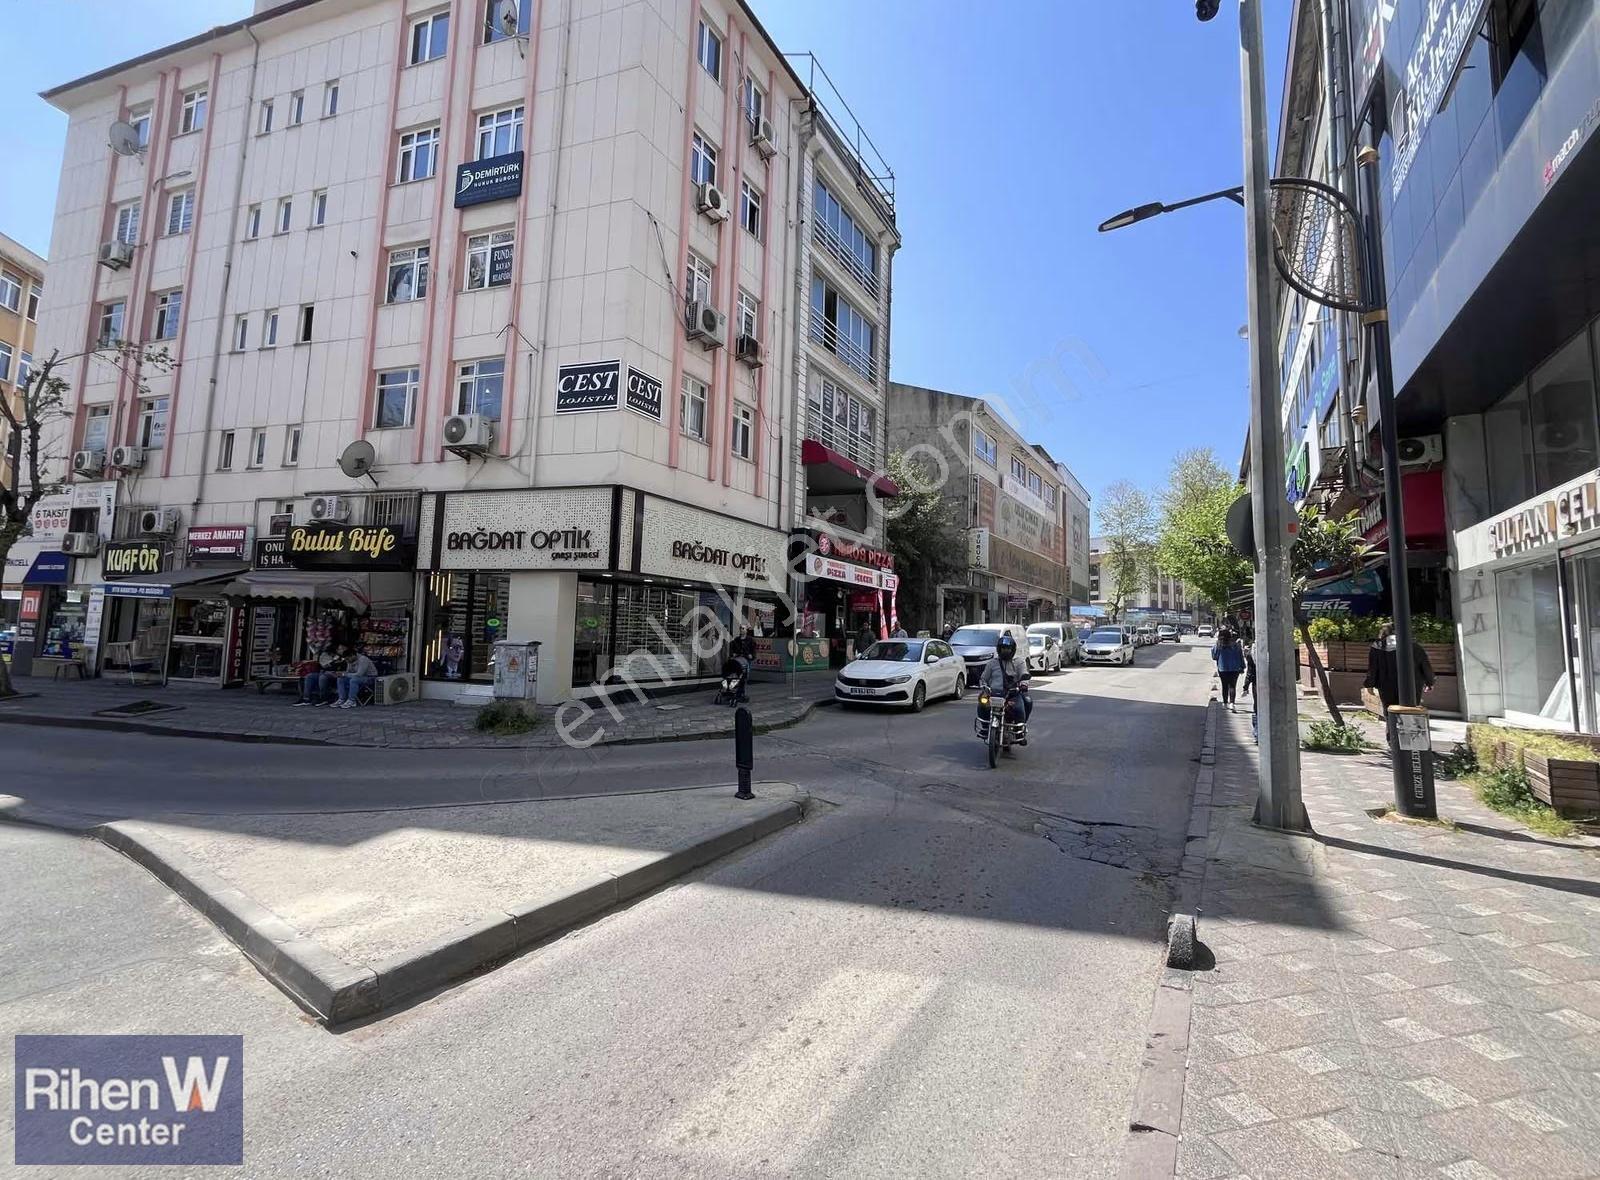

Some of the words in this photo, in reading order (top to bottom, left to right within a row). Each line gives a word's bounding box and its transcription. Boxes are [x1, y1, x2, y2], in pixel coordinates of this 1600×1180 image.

[475, 162, 520, 180] DEMİRTÜRK
[559, 370, 618, 393] CEST
[628, 374, 662, 403] CEST
[559, 393, 616, 405] LOJİSTİK
[628, 395, 659, 414] LOJİSTİK
[42, 507, 69, 518] TAKSİT
[189, 532, 212, 540] MERKEZ
[213, 530, 244, 540] ANAHTAR
[447, 526, 527, 550] BAĞDAT
[530, 525, 591, 550] OPTİK
[1488, 500, 1557, 553] SULTAN
[291, 528, 345, 552] Bulut
[349, 527, 396, 559] Büfe
[672, 540, 730, 566] BAĞDAT
[106, 543, 160, 573] KUAFÖR
